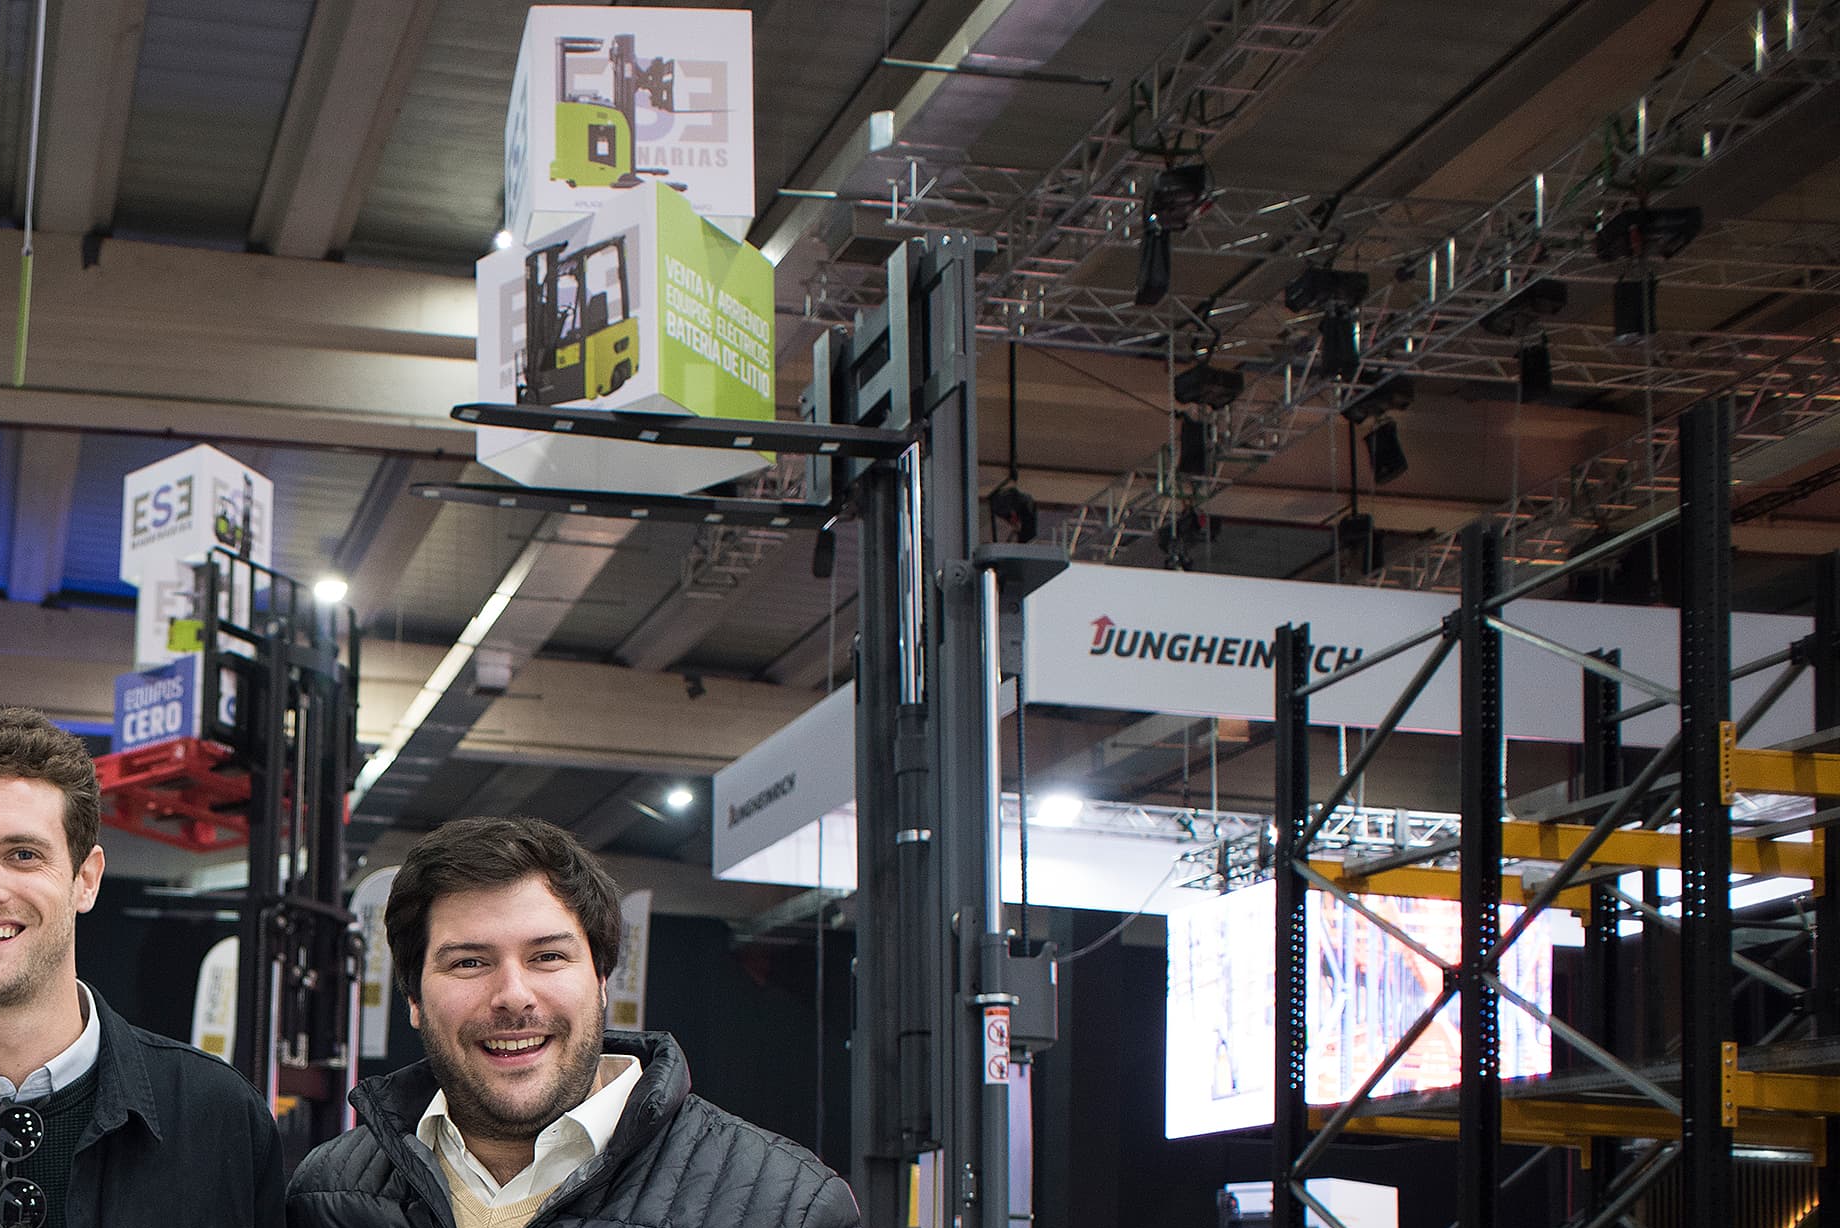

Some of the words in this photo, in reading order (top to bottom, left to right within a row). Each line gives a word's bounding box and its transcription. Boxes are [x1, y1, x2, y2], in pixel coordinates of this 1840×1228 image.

[665, 255, 704, 299] VENTA
[706, 280, 715, 305] Y
[718, 289, 769, 345] ARRIENDO
[666, 283, 712, 331] EQUIPOS
[666, 311, 721, 367] BATERÍA
[722, 344, 739, 379] DE
[740, 357, 770, 399] LITIO
[124, 674, 185, 712] EQUIPOS
[123, 700, 183, 743] CERO
